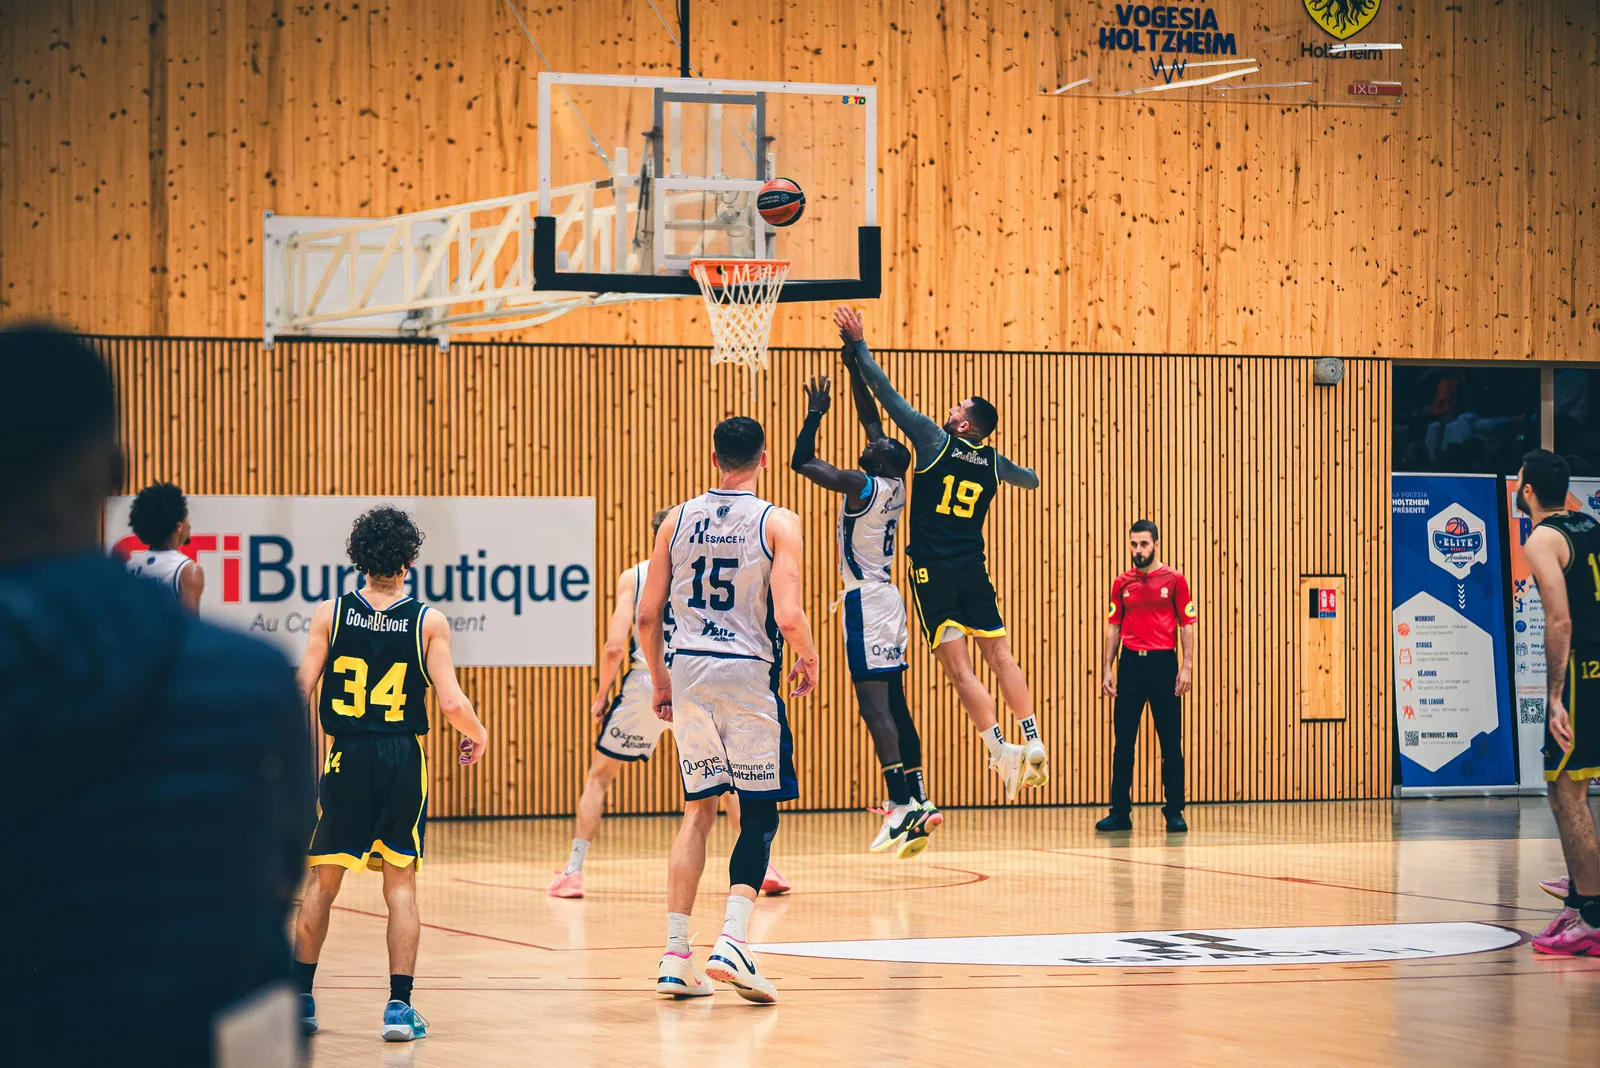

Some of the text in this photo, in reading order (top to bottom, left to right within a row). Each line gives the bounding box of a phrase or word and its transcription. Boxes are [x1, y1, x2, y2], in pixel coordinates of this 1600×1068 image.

[1115, 3, 1219, 31] VOGESIA
[1099, 27, 1237, 55] HOLTZHEIM
[935, 474, 984, 519] 19
[1392, 498, 1430, 507] HOLTZHEIM
[1443, 537, 1474, 547] ELITE
[249, 534, 590, 616] Burautique
[687, 556, 739, 611] 15
[915, 568, 930, 584] 19
[1581, 661, 1600, 679] 12
[332, 655, 408, 722] 34
[682, 756, 722, 776] Quone
[765, 762, 775, 770] de
